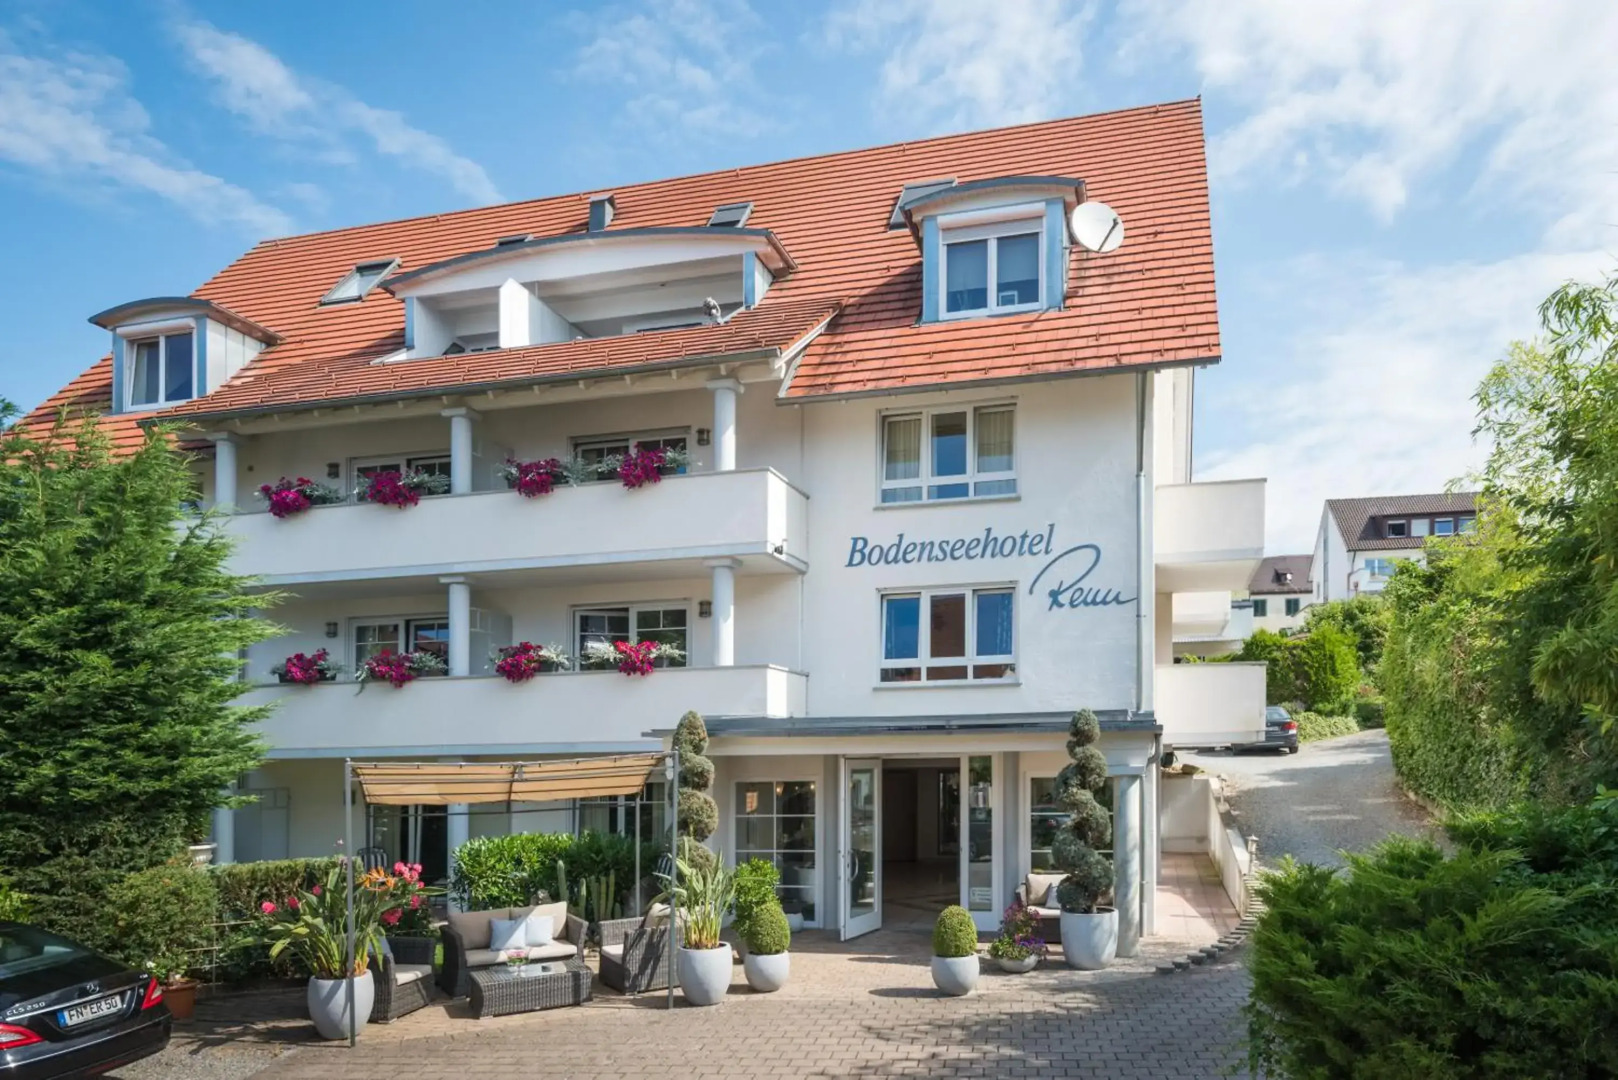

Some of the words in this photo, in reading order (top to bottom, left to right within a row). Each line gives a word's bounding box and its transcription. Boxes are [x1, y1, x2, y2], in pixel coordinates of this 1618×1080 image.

[845, 523, 1056, 567] Bodenseehotel
[6, 1007, 25, 1016] CLS
[68, 1007, 84, 1021] FN
[89, 1001, 104, 1015] ER
[104, 997, 118, 1011] 50
